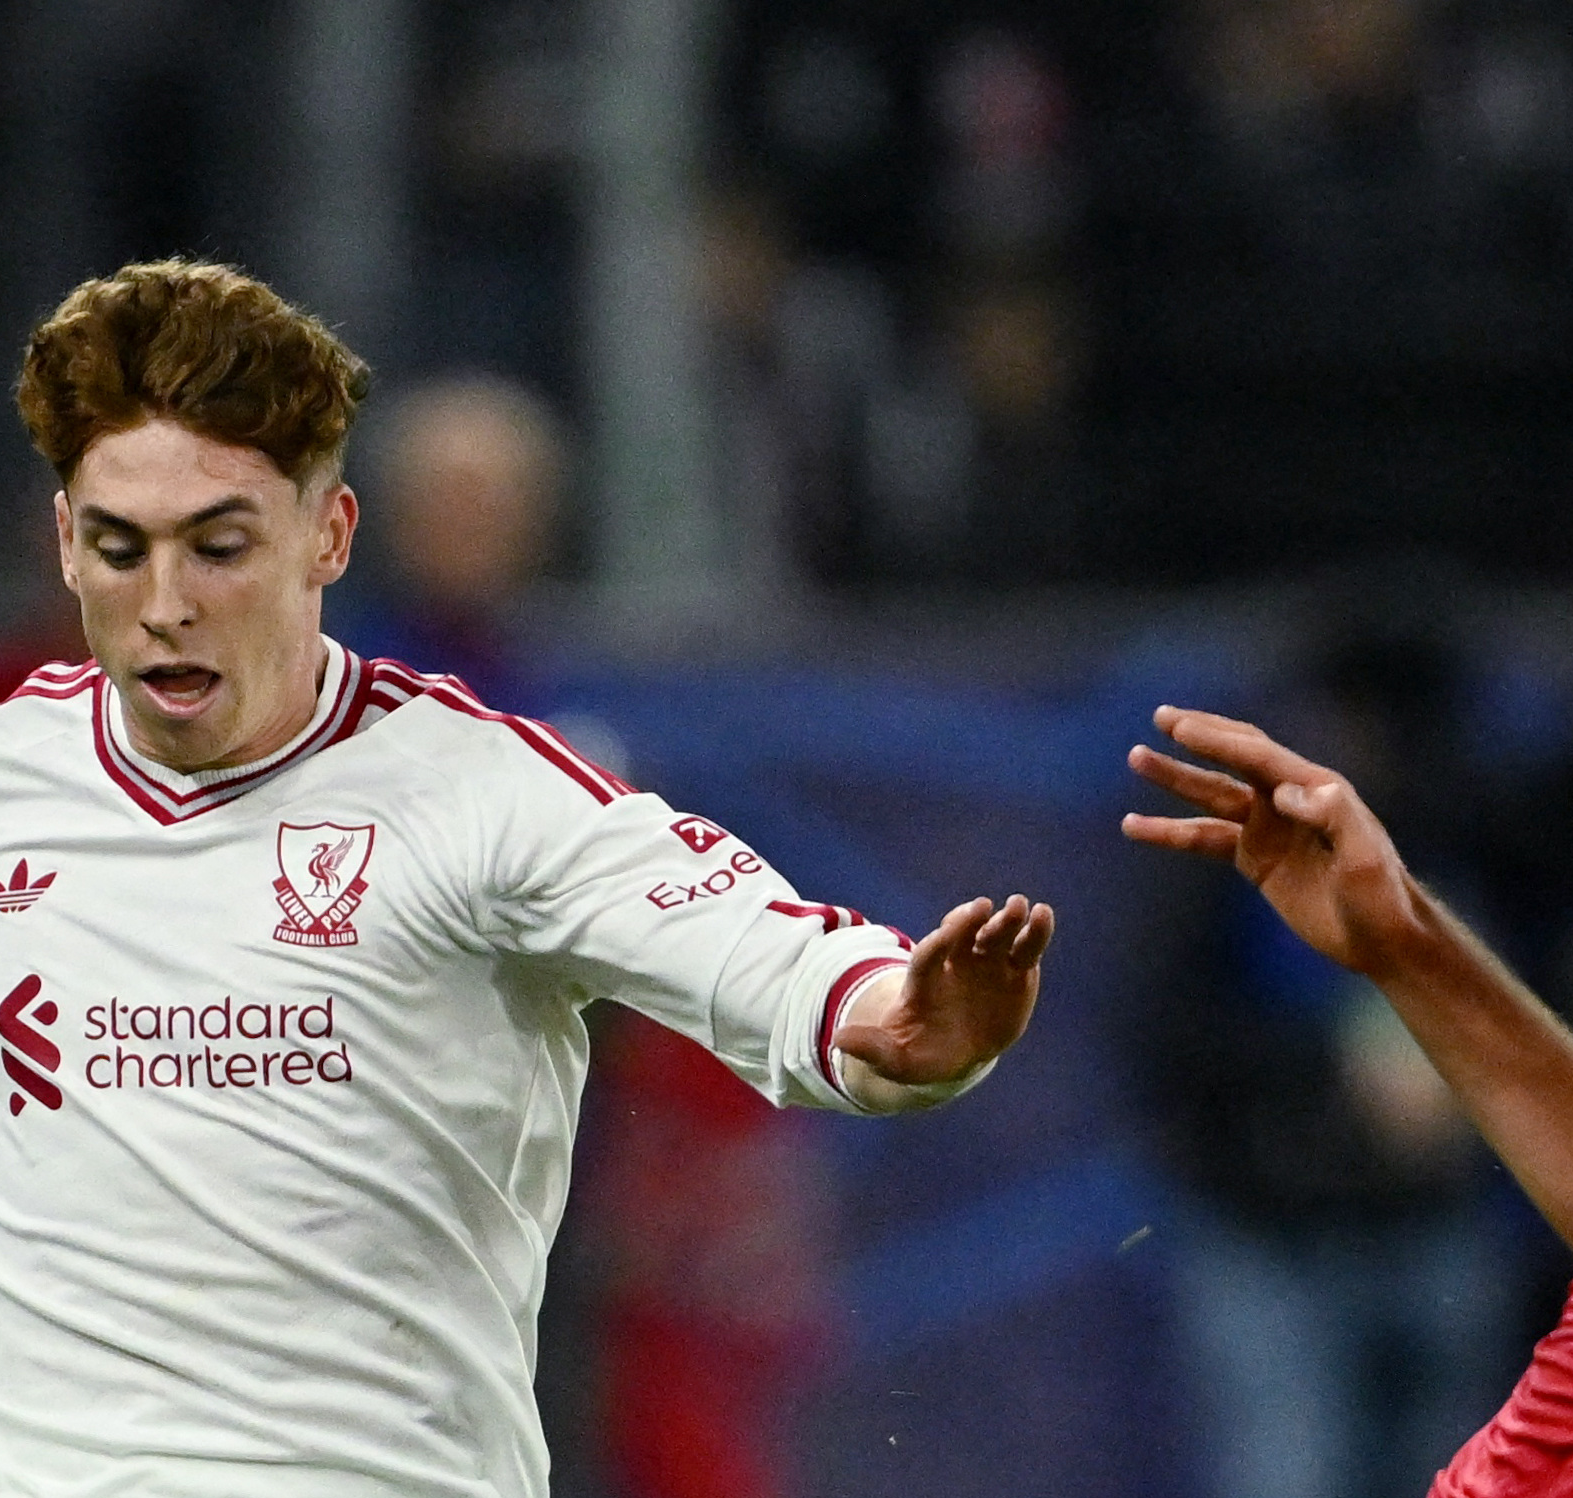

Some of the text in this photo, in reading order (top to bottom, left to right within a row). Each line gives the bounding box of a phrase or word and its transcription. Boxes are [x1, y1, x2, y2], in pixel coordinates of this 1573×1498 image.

[279, 890, 358, 931] LIVER POOL
[275, 926, 356, 946] FOOTBALL CLUB
[84, 995, 333, 1041] standard
[84, 1042, 353, 1090] chartered
